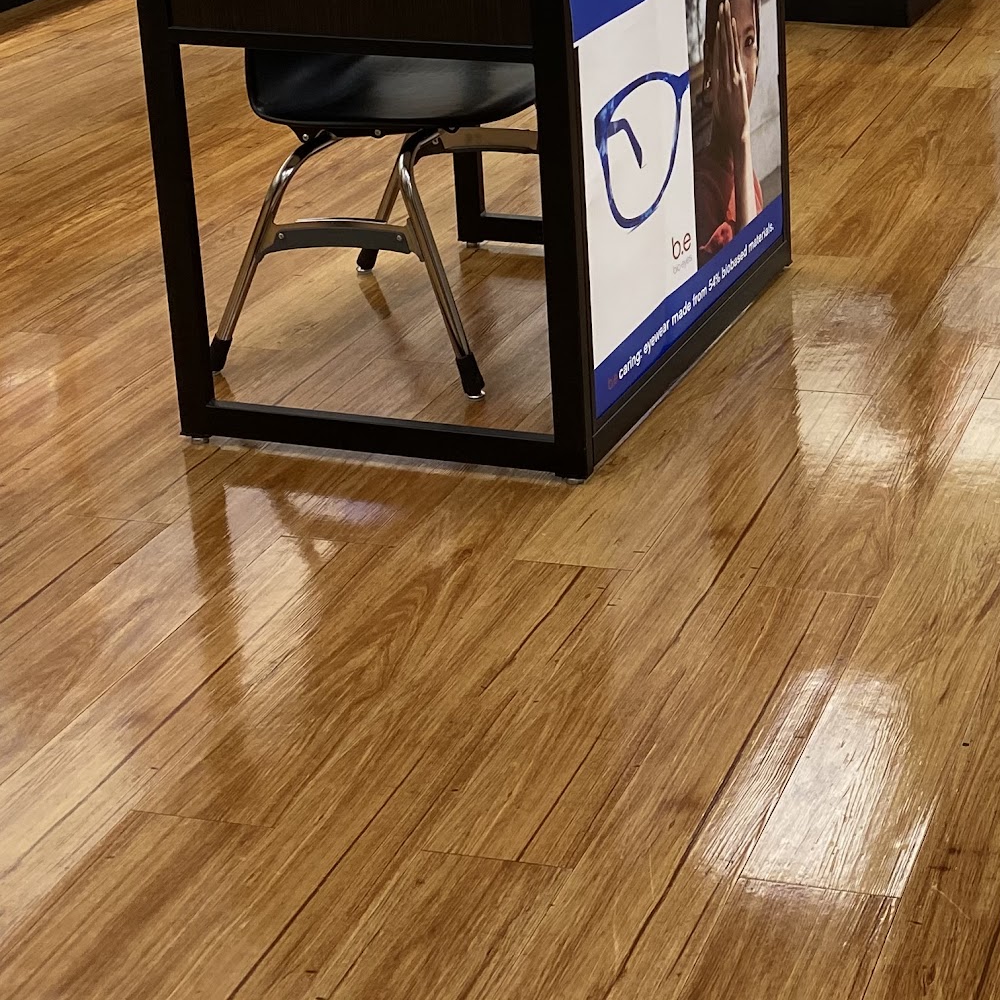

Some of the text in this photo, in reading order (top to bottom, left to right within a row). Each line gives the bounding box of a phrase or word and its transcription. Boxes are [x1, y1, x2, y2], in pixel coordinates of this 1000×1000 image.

[671, 232, 692, 260] b.e
[618, 350, 643, 381] caring:
[643, 319, 671, 355] eyewear
[671, 300, 692, 326] made
[691, 285, 708, 307] from
[707, 274, 721, 292] 54%
[721, 247, 748, 279] biobased
[747, 221, 775, 254] materials.
